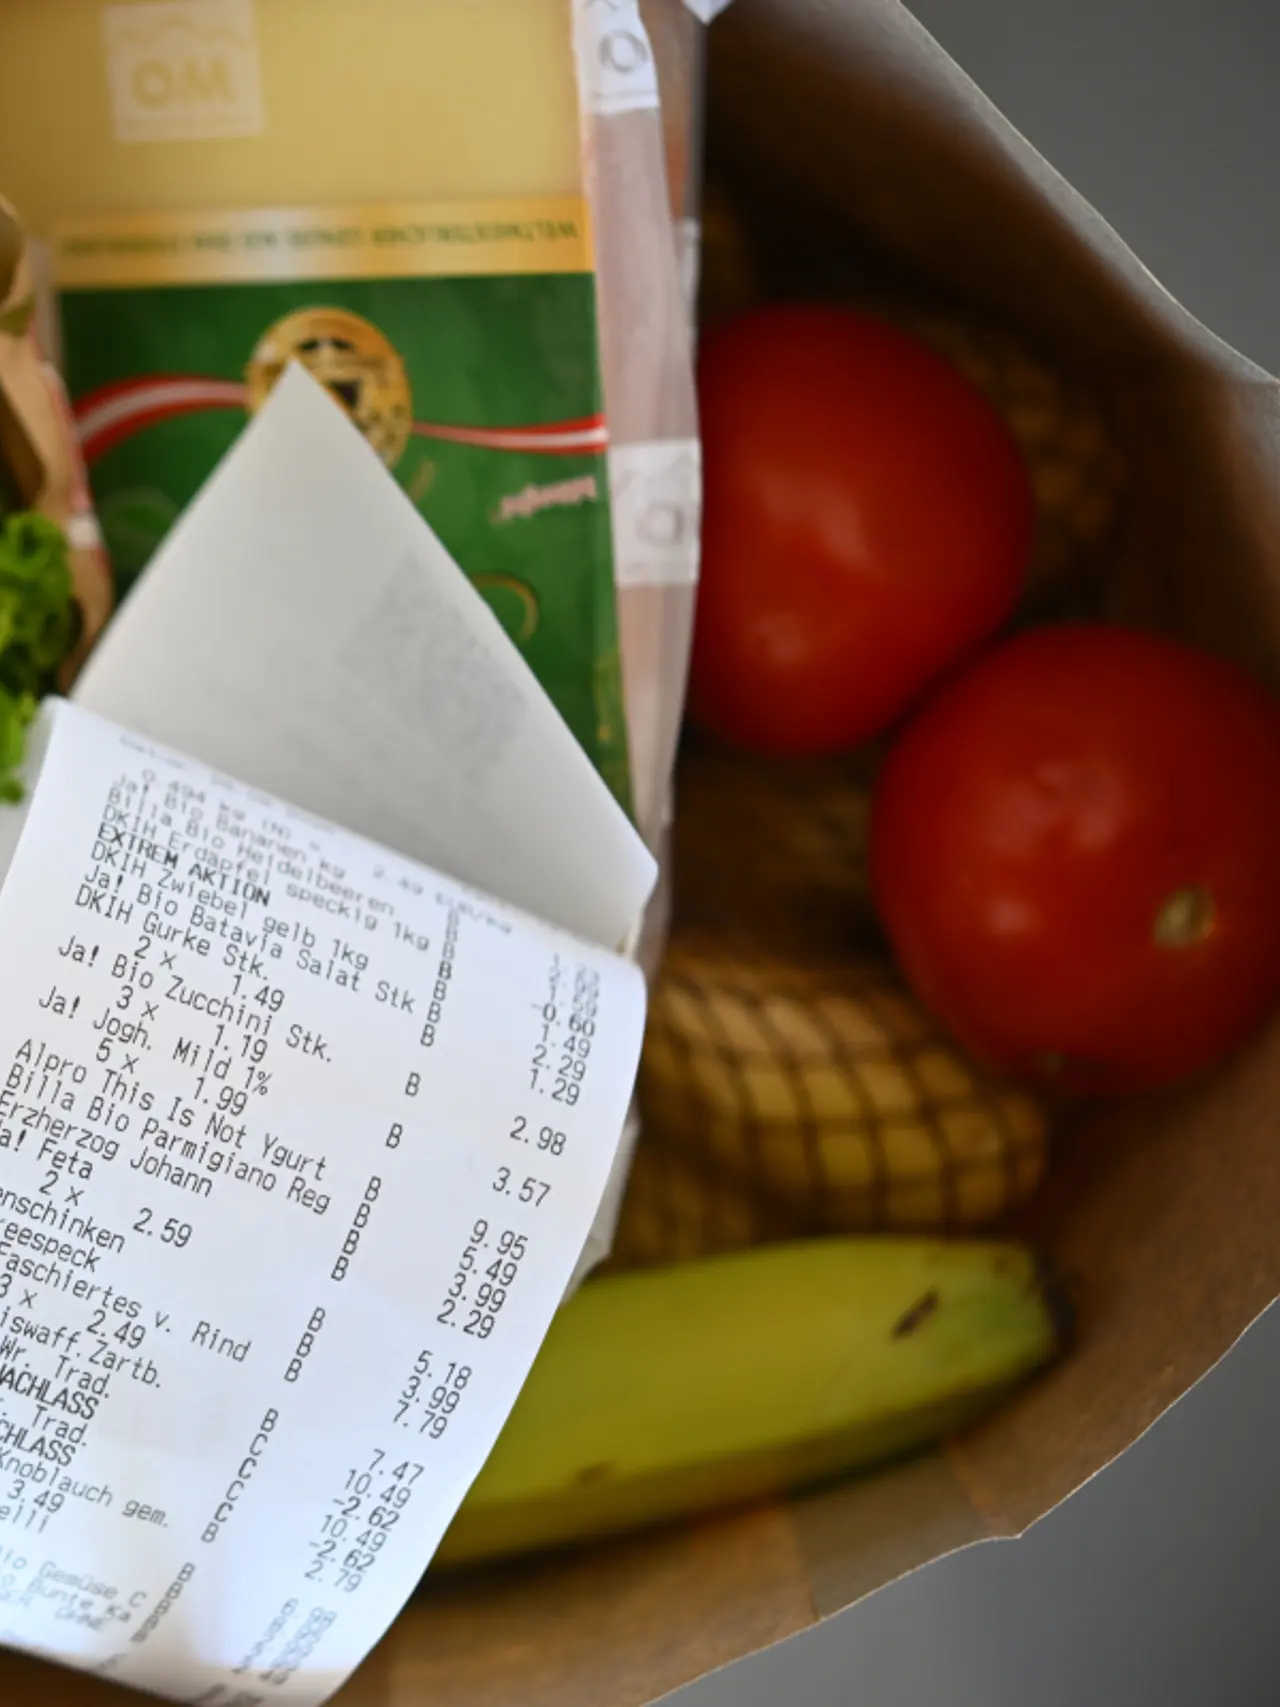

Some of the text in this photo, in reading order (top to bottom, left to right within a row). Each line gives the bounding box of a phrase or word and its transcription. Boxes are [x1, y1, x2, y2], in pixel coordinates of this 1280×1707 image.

[102, 804, 156, 837] DKIH
[286, 884, 377, 931] speckig
[395, 922, 429, 951] 1kg
[185, 819, 224, 849] Bio
[85, 865, 585, 1081] Ja! Bio Batavia Salat Stk B 2.29
[91, 840, 590, 1058] DKIH Zwiebel gelb 1kg B 1.49
[98, 822, 178, 868] EXTREM
[188, 863, 270, 906] AKTION
[533, 1003, 595, 1036] -0.60
[134, 935, 284, 1012] 2 x 1.49
[58, 935, 566, 1155] Ja! Bio Zucchini Stk. B 2.98
[75, 883, 579, 1106] DKIH Gurke Stk. B 1.29
[116, 985, 267, 1063] 3 x 1.19
[38, 986, 550, 1206] Ja! Jogh. Mild 1% B 3.57
[96, 1037, 247, 1116] 5 x 1.99
[6, 1063, 517, 1286] Billa Bio Parmigiano Reg B 5.49
[15, 1039, 527, 1260] Alpro This Is Not Ygurt B 9.95
[37, 1138, 92, 1179] Feta
[330, 1255, 348, 1281] B
[436, 1298, 494, 1339] 2.29
[38, 1170, 192, 1247] 2 x 2.59
[130, 1147, 212, 1197] Johann
[342, 1229, 359, 1255] B
[448, 1272, 505, 1312] 3.99
[19, 1289, 37, 1308] x
[86, 1309, 145, 1349] 2.49
[296, 1332, 314, 1357] B
[402, 1375, 459, 1413] 3.99
[307, 1306, 325, 1332] B
[414, 1350, 471, 1389] 5.18
[155, 1311, 170, 1332] v.
[191, 1321, 251, 1361] Rind
[283, 1358, 302, 1382] B
[393, 1399, 447, 1439] 7.79
[32, 1404, 87, 1446] Trad.
[225, 1480, 244, 1501] C
[321, 1514, 386, 1552] 10.49
[55, 1355, 110, 1398] Trad.
[249, 1433, 267, 1456] C
[345, 1469, 410, 1508] 10.49
[260, 1408, 278, 1432] B
[369, 1448, 424, 1484] 7.47
[7, 1479, 64, 1513] 3.49
[121, 1500, 167, 1527] gem.
[200, 1522, 218, 1543] B
[304, 1559, 361, 1592] 2.79
[214, 1502, 233, 1522] C
[309, 1539, 375, 1571] -2.62
[238, 1457, 257, 1479] C
[333, 1496, 399, 1529] -2.62
[177, 1562, 195, 1582] B
